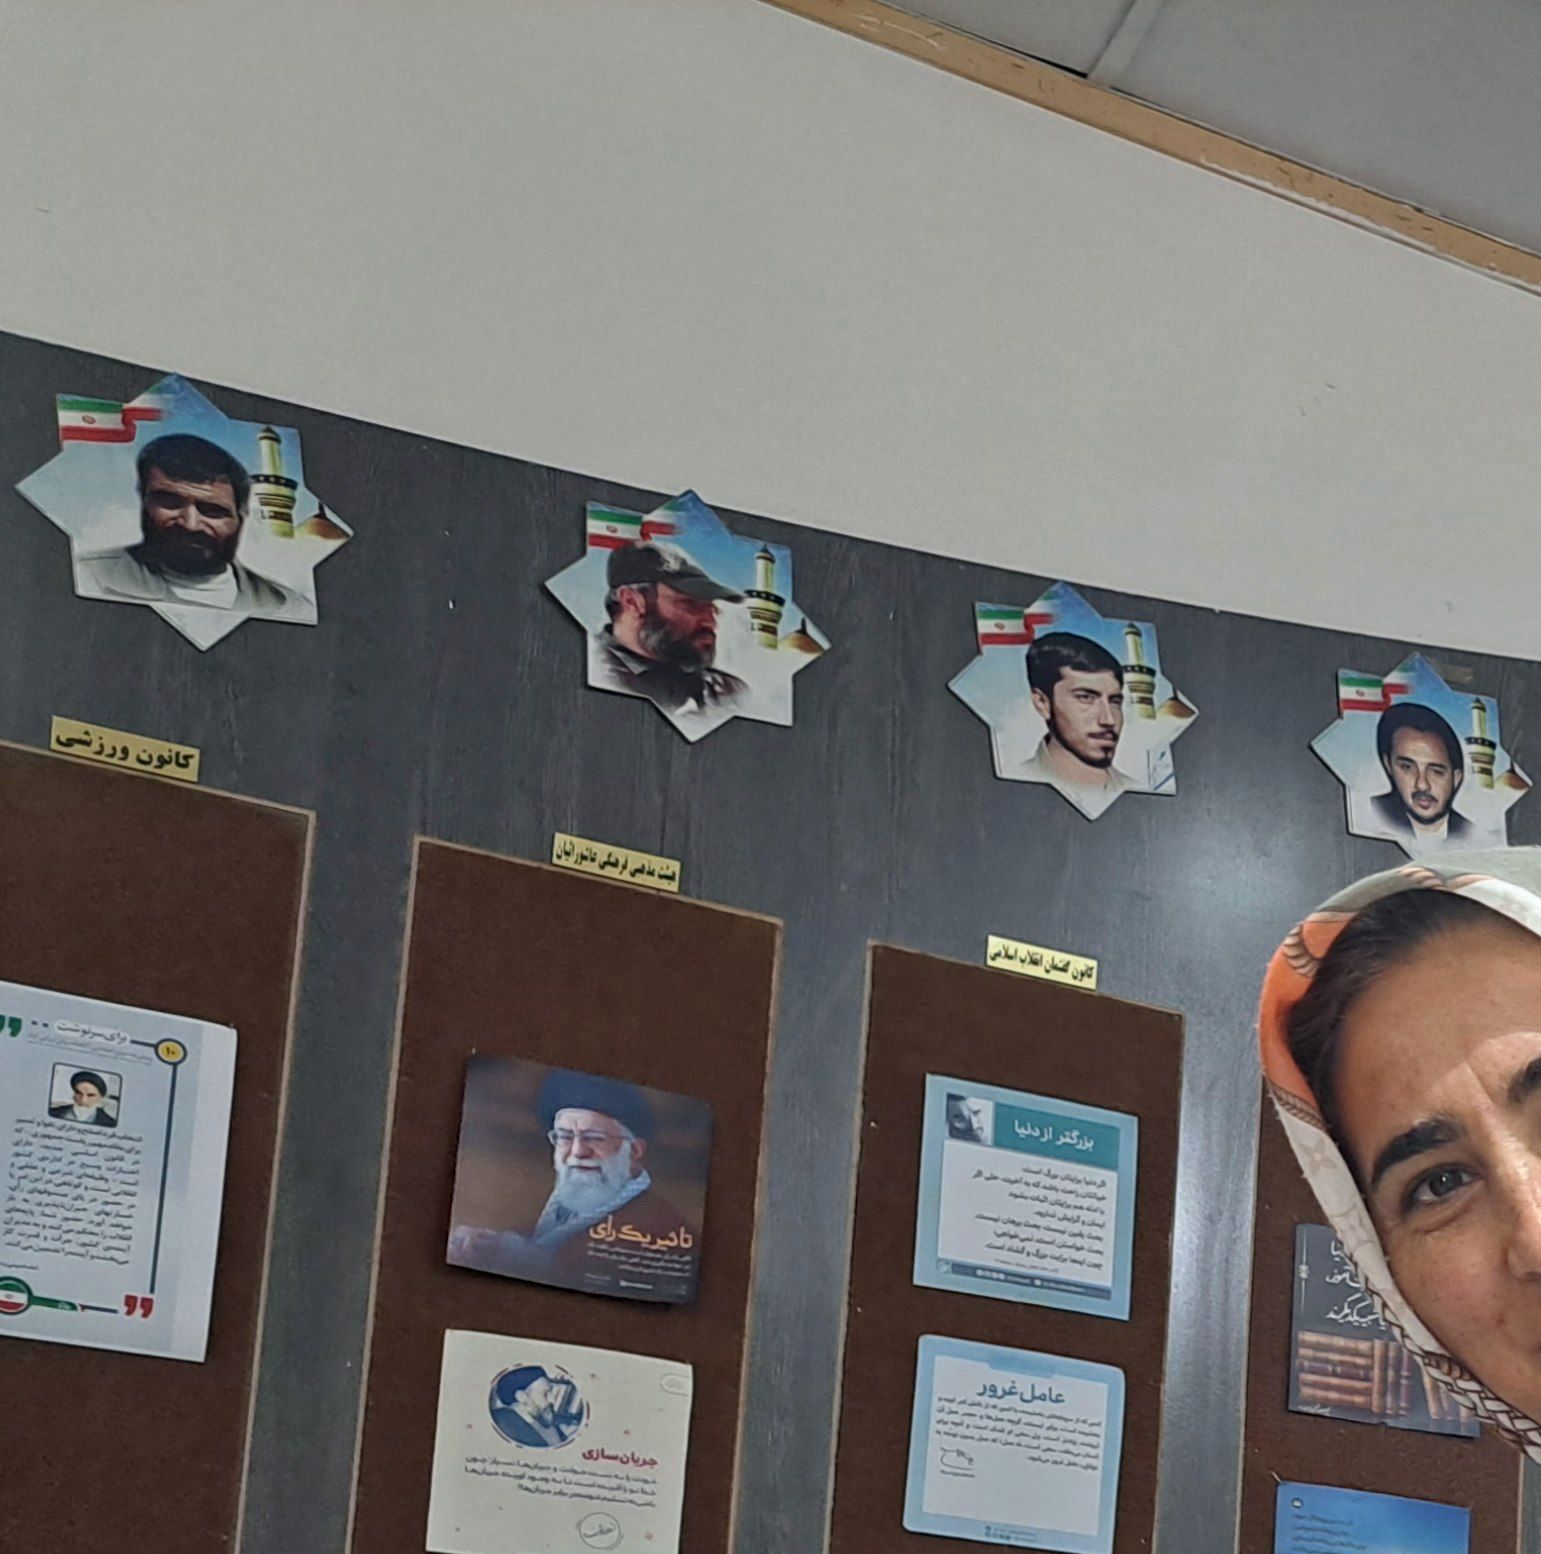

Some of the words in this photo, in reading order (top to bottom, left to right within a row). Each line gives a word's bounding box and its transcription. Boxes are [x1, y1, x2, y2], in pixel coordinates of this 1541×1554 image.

[55, 729, 130, 761] ورزشی
[135, 748, 195, 769] کانون
[598, 852, 629, 876] فرهنگی
[630, 863, 656, 878] مذهبی
[989, 944, 1018, 961] اسلامی
[1019, 950, 1043, 968] انقلاب
[1071, 964, 1095, 981] کانون
[1014, 1119, 1041, 1137] دنیا
[1040, 1126, 1053, 1142] از
[1056, 1126, 1094, 1152] بزرگتر
[618, 1224, 652, 1242] یک
[641, 1226, 693, 1251] تاثیر
[976, 1379, 1019, 1397] غرور
[1020, 1383, 1066, 1404] عامل
